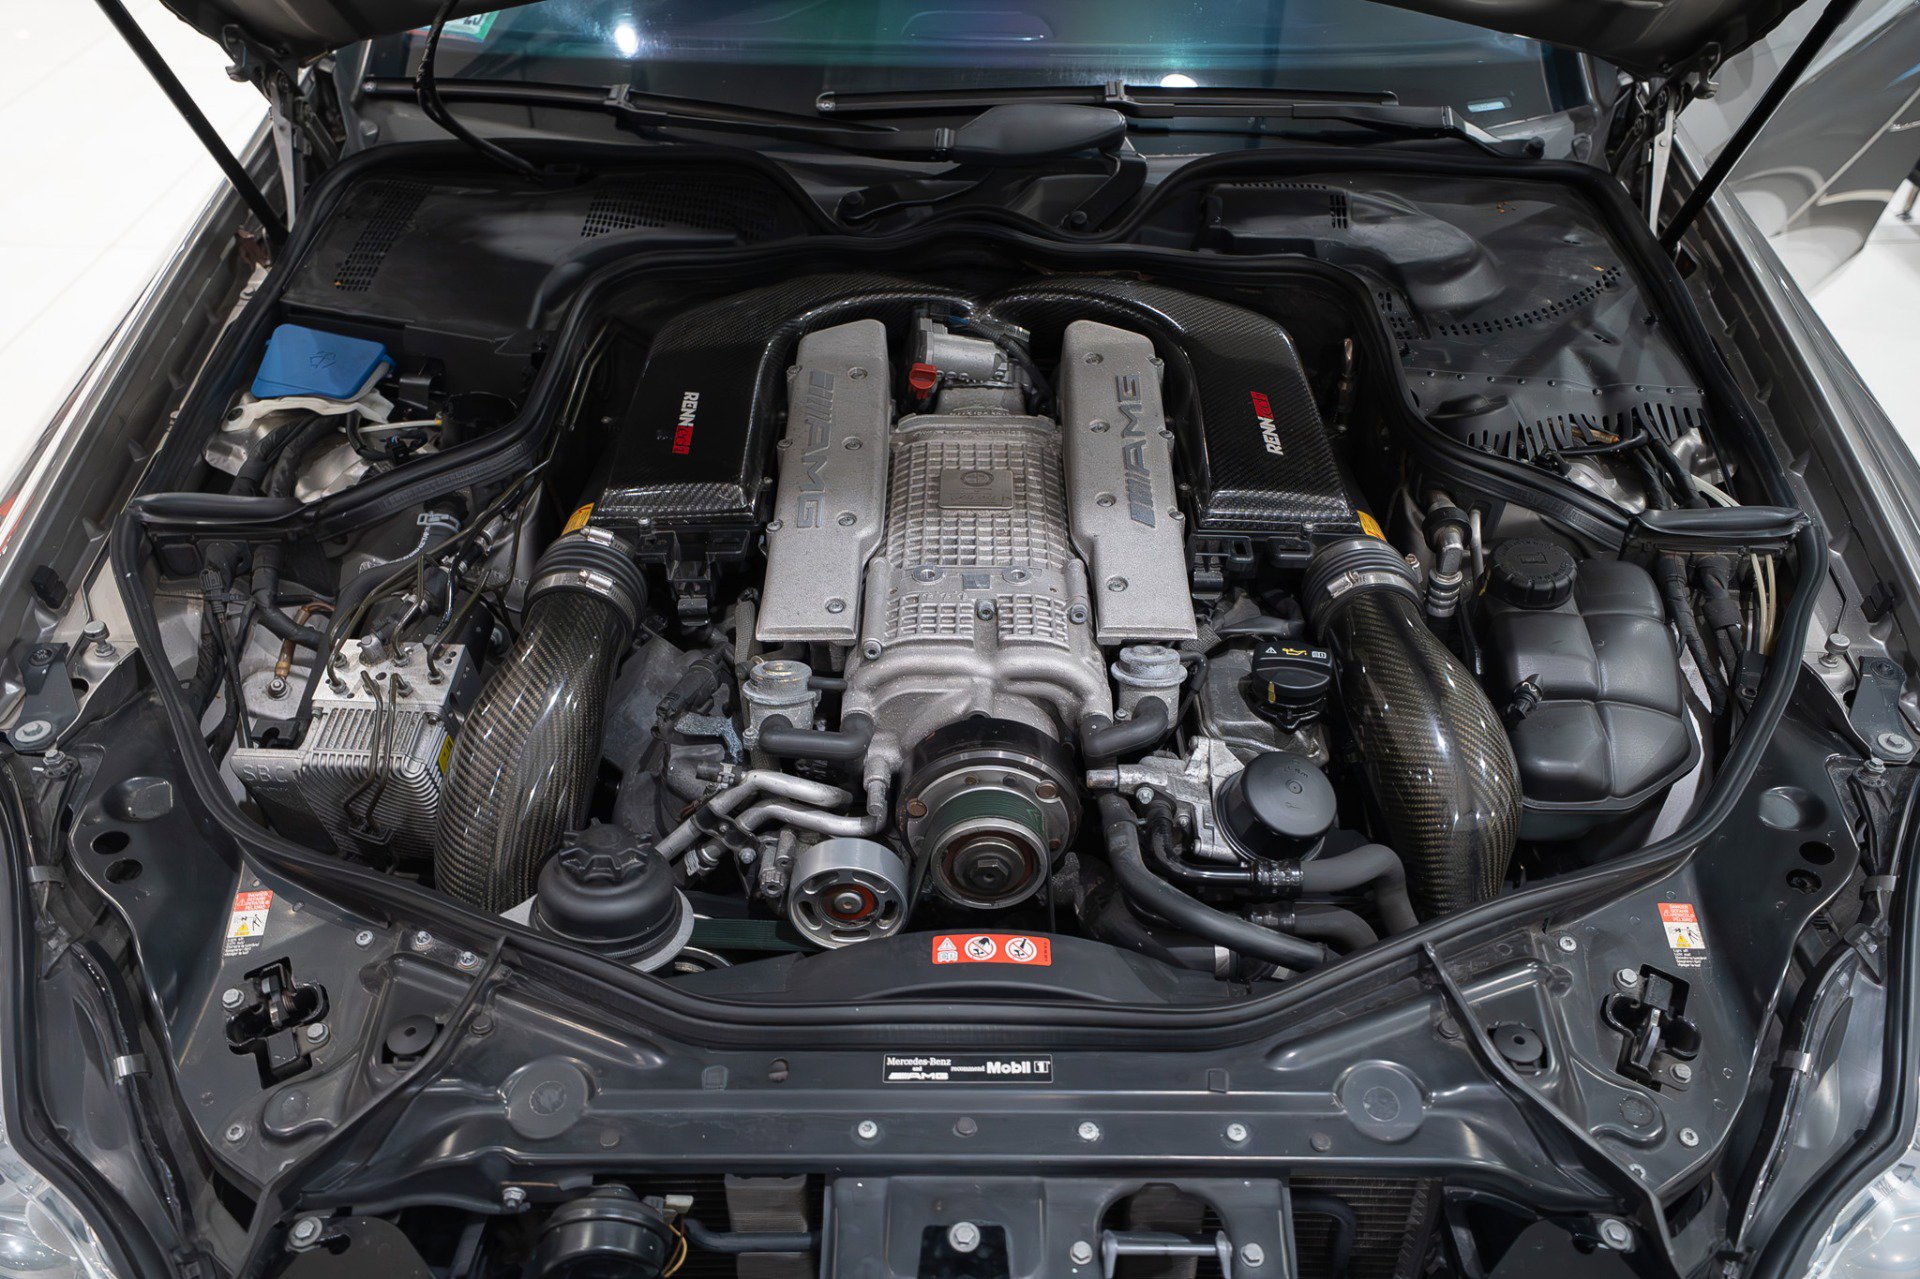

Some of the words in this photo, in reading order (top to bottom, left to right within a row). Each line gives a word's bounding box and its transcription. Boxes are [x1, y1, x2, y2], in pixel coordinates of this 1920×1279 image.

[1115, 374, 1151, 477] AMG
[797, 415, 831, 528] AMG
[242, 763, 288, 782] SBC
[886, 1057, 951, 1066] Mercedes-Benz
[986, 1061, 1031, 1074] Mobil
